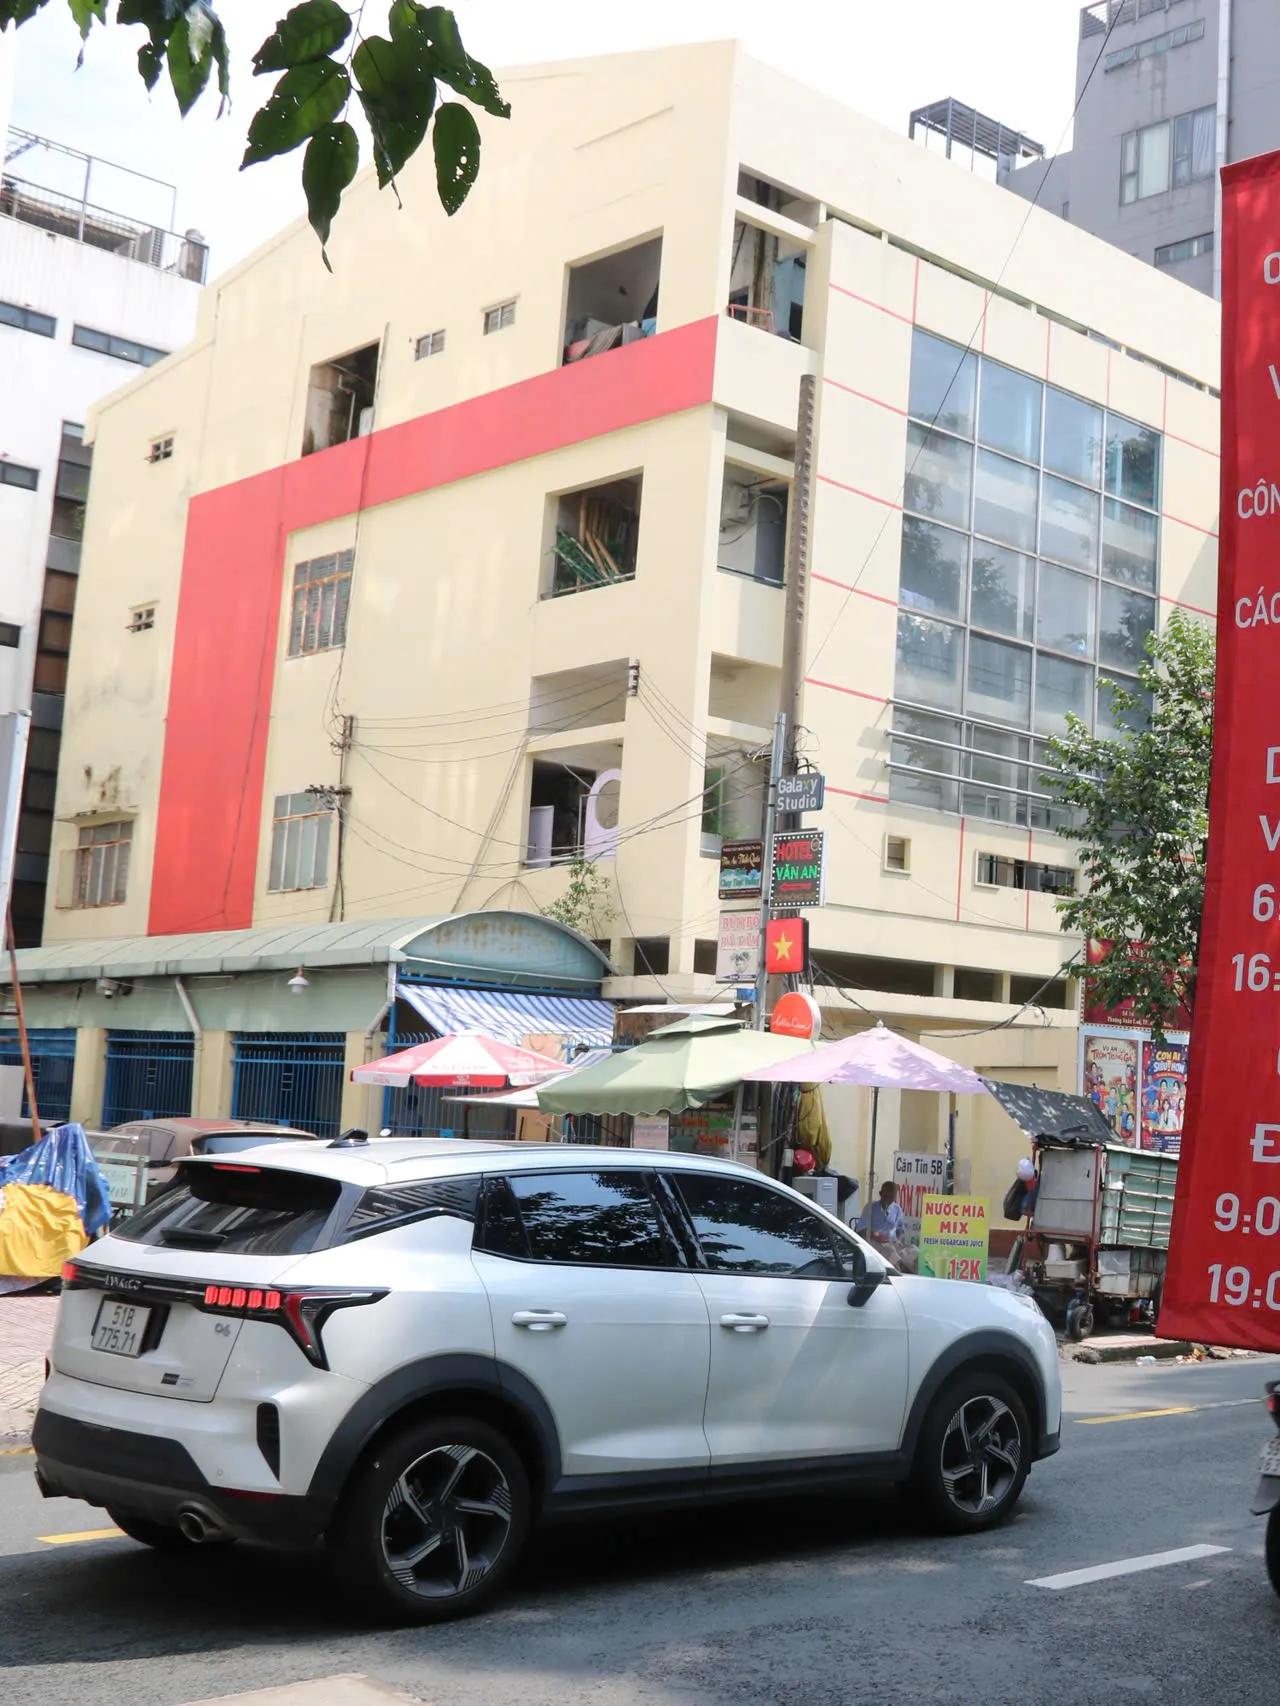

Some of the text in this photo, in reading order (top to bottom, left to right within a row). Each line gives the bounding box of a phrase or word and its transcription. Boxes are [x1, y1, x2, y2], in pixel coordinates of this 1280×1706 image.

[777, 778, 818, 795] Galaxy
[776, 795, 817, 811] Studio
[776, 840, 813, 861] HOTEL
[775, 863, 818, 880] VĂN AN
[896, 1156, 912, 1174] Căn
[930, 1159, 943, 1176] 5B
[925, 1200, 960, 1217] NƯỚC
[940, 1220, 969, 1235] MIX
[923, 1237, 984, 1248] FRESH SUGARCANE JUICE
[950, 1258, 982, 1280] 12K
